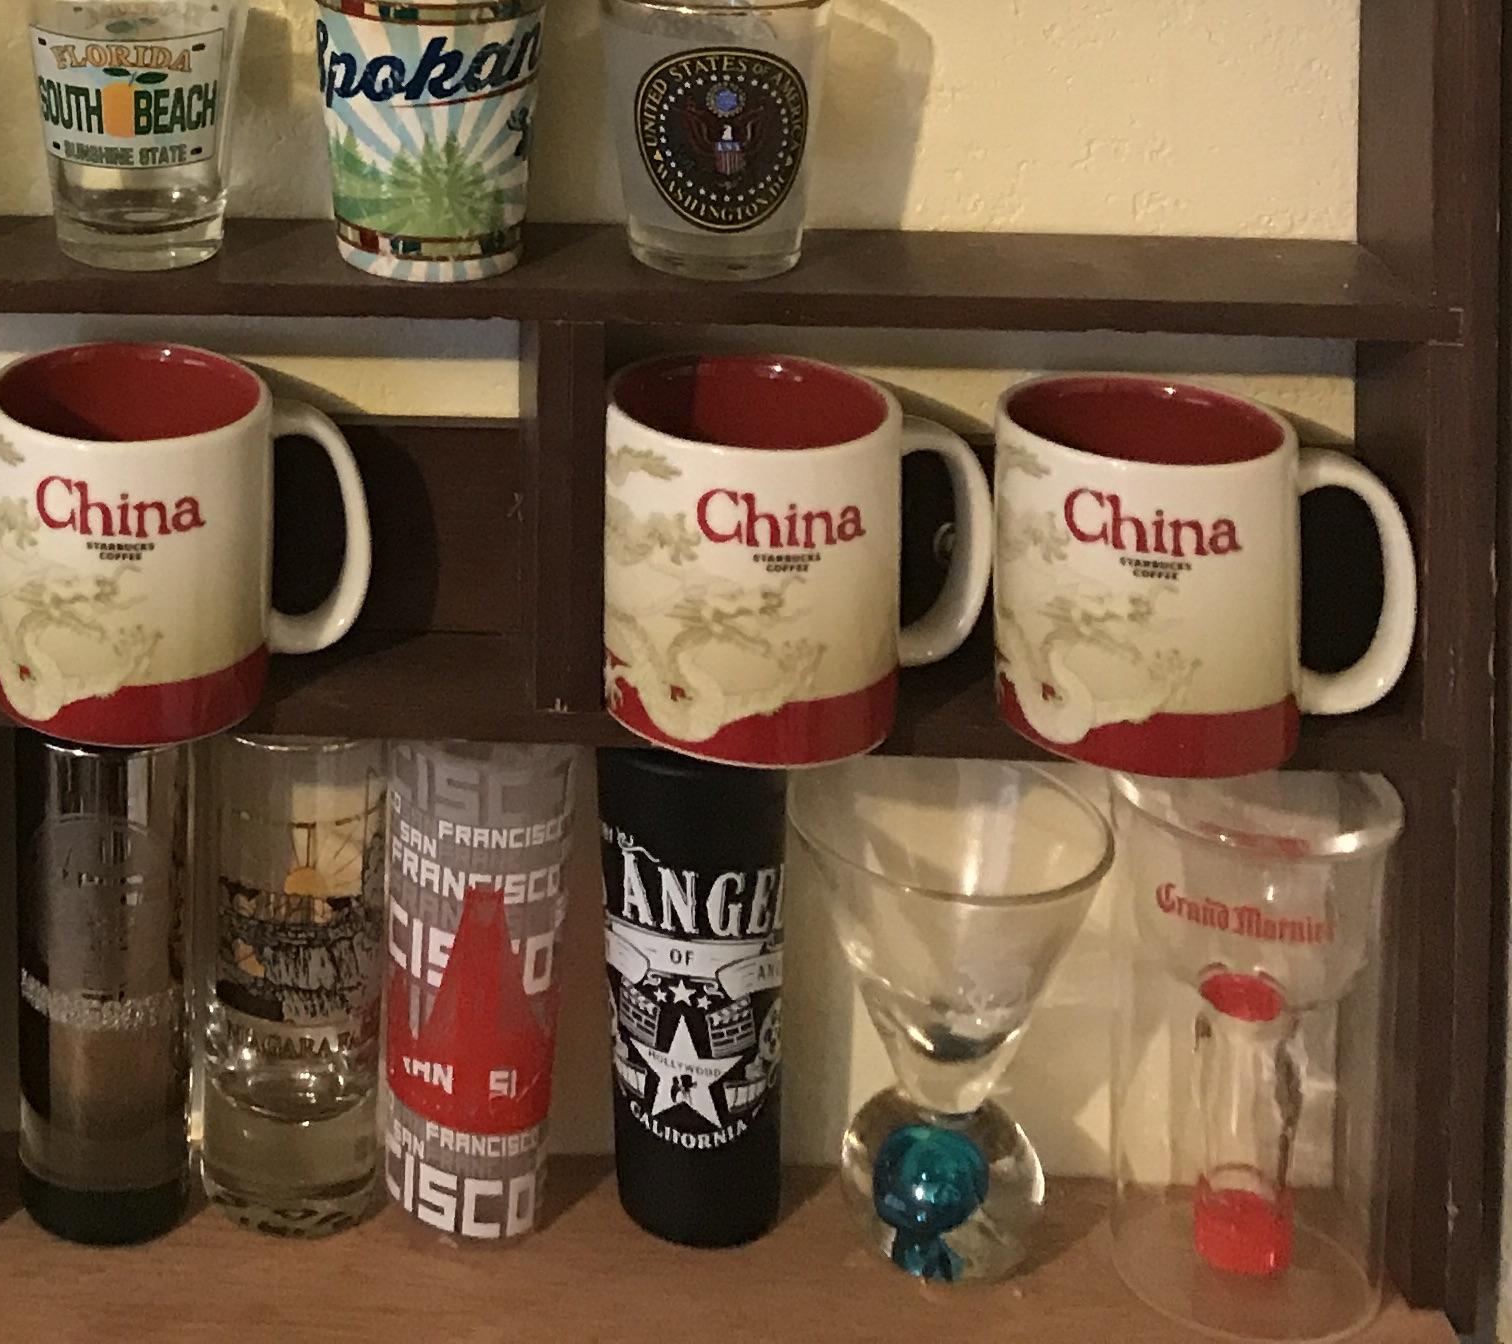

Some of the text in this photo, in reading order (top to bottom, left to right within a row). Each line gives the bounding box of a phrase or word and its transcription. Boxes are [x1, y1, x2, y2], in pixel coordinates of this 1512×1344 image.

[50, 42, 193, 74] FLORIDA
[38, 75, 218, 137] SOUTH BEACH
[643, 78, 668, 148] UNITED
[669, 55, 748, 82] STATES
[769, 72, 807, 151] AMERICA
[63, 142, 188, 166] SUNSHINE STATE
[36, 475, 206, 538] China
[696, 487, 868, 550] China
[1064, 486, 1243, 557] China
[86, 541, 155, 553] STARBUCKS
[99, 552, 143, 561] COFFEE
[752, 553, 822, 564] STARBUCKS
[1119, 555, 1193, 571] STARBUCKS
[400, 820, 437, 858] SAN
[1155, 883, 1230, 931] Grand
[669, 948, 694, 966] OF
[647, 1048, 723, 1079] HOLLYWOOD
[629, 1098, 749, 1151] CALIFORNIA
